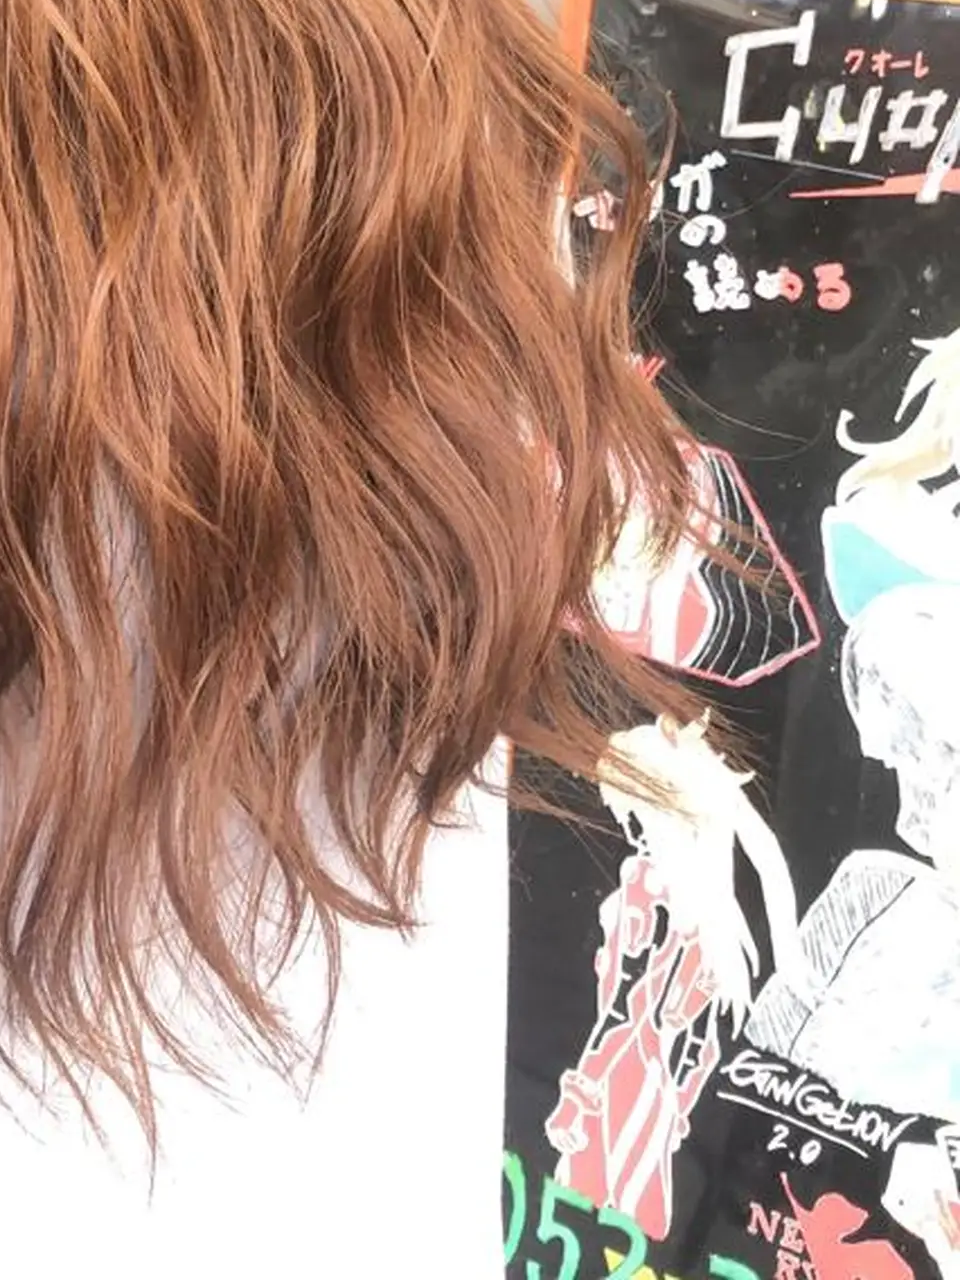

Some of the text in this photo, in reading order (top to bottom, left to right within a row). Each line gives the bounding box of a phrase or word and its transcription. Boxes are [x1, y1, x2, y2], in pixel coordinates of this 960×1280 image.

[844, 49, 929, 78] クオーレ
[767, 1124, 821, 1166] 2.0
